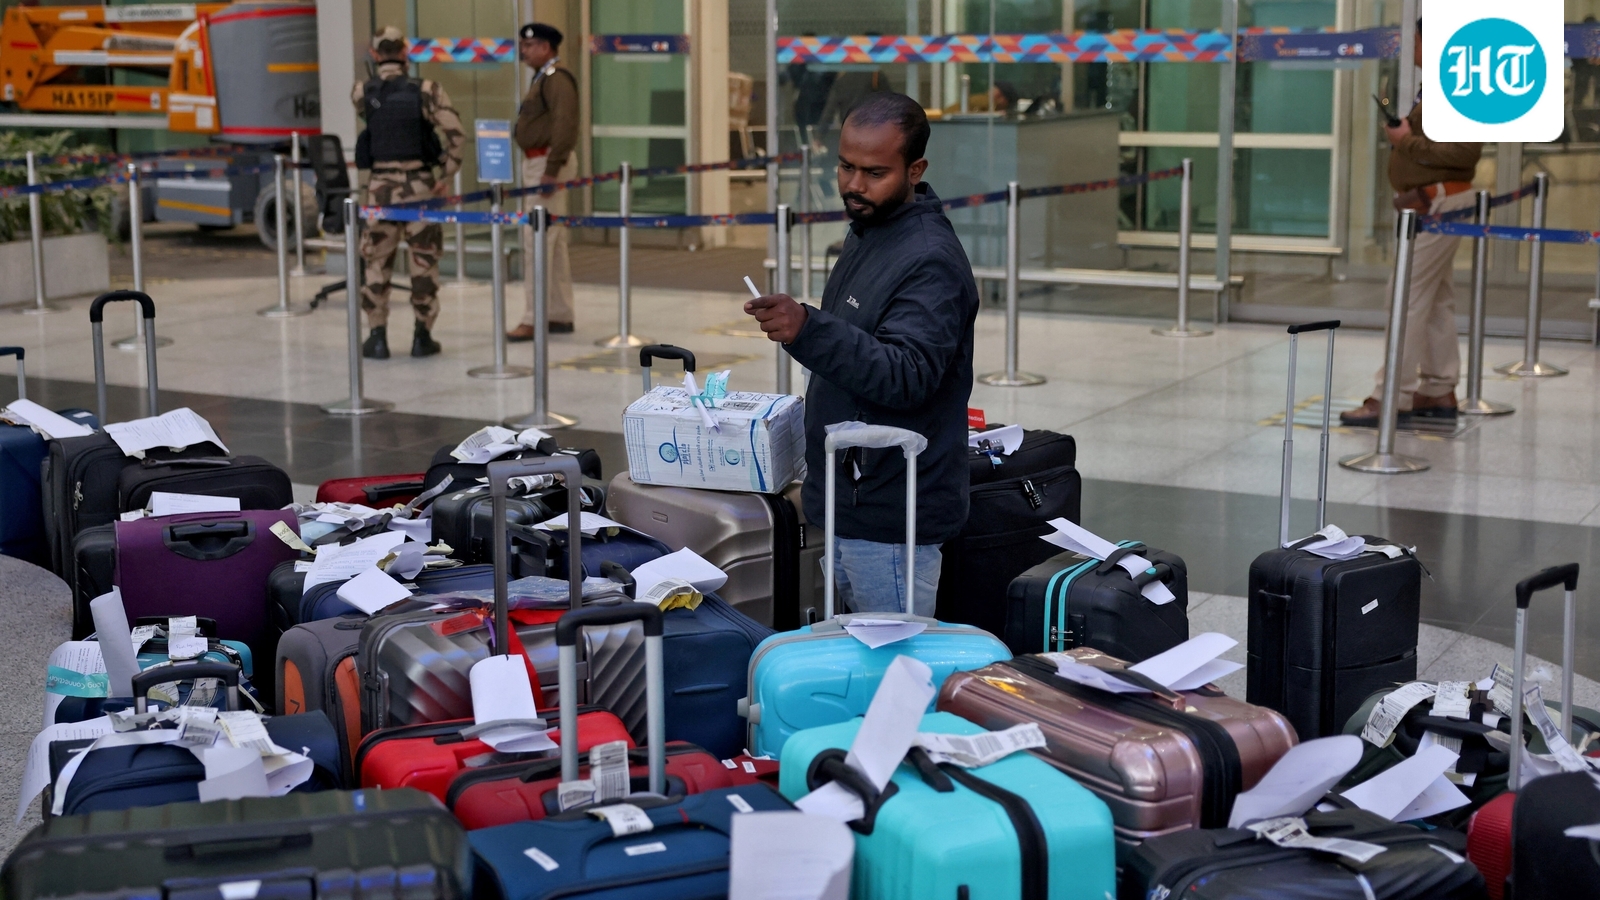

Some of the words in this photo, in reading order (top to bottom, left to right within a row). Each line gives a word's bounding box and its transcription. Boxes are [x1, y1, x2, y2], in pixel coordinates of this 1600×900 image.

[52, 90, 114, 106] HA15IP
[49, 675, 86, 690] Connection
[87, 681, 105, 689] Long
